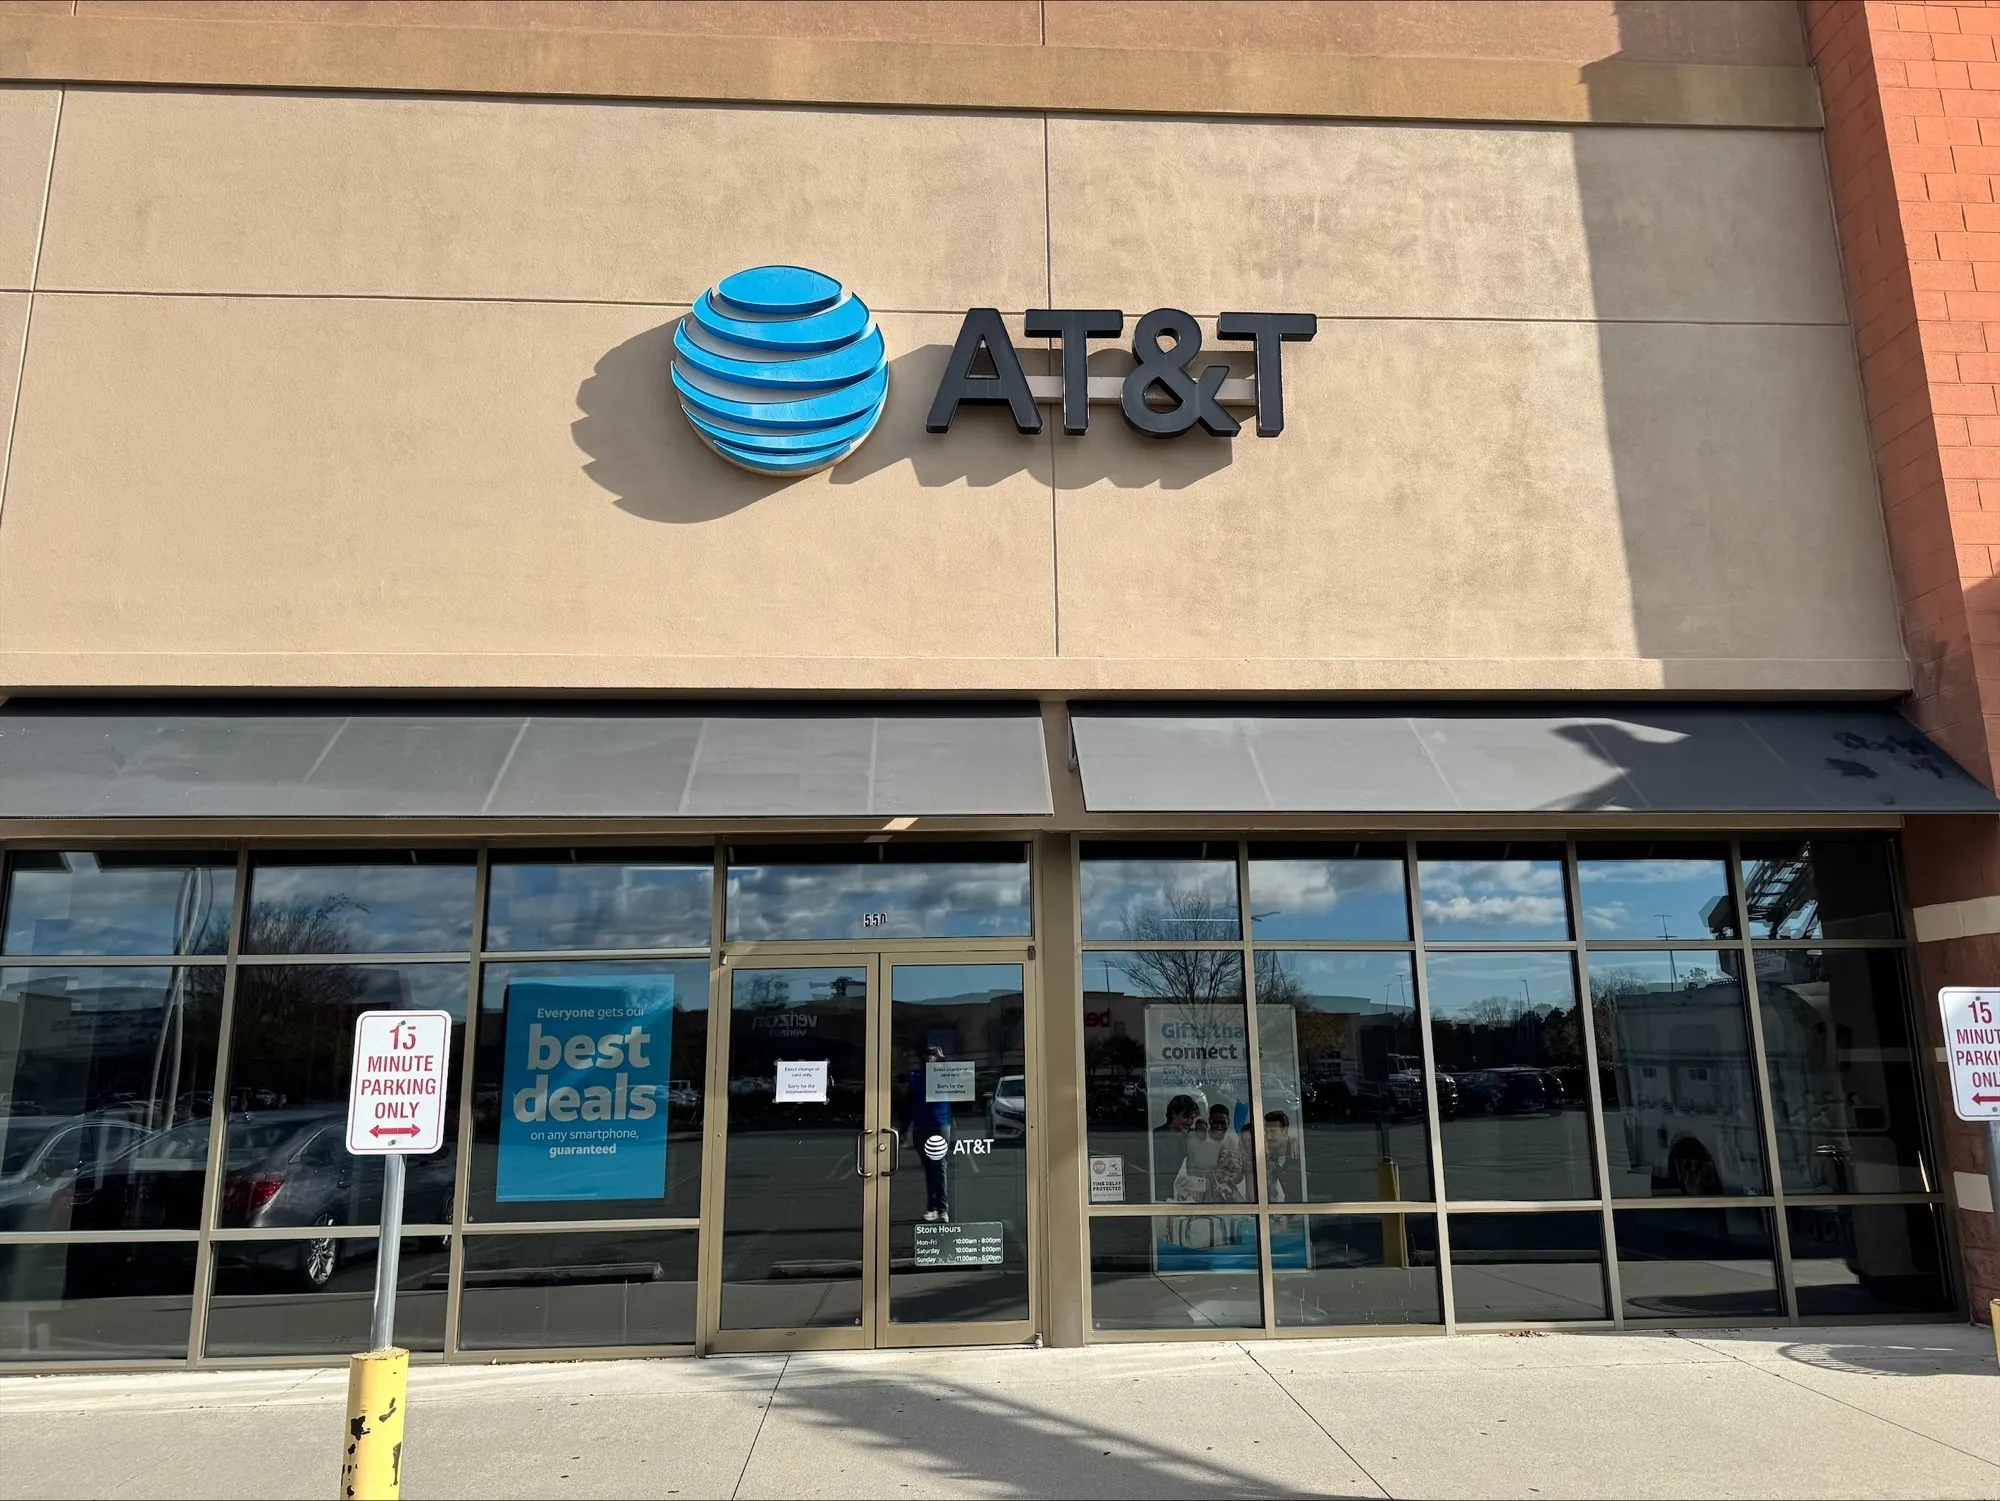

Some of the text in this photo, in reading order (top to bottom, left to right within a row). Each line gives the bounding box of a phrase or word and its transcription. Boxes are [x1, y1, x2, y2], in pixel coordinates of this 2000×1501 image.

[925, 307, 1317, 439] AT&T
[537, 1007, 645, 1021] Everyone gets our
[1968, 1000, 1993, 1024] 15
[389, 1023, 417, 1051] 15
[1214, 1022, 1245, 1039] tha
[527, 1023, 651, 1071] best
[1161, 1044, 1238, 1060] connect
[367, 1055, 434, 1073] MINUTE
[1956, 1051, 2000, 1066] PARKI
[361, 1078, 437, 1096] PARKING
[1972, 1072, 2000, 1088] ONL
[513, 1073, 657, 1123] deals
[374, 1101, 420, 1119] ONLY
[530, 1128, 639, 1143] on any smartphone,
[549, 1144, 617, 1157] guaranteed
[953, 1139, 994, 1155] AT&T
[916, 1225, 961, 1234] Store Hours
[916, 1256, 937, 1264] Sunday
